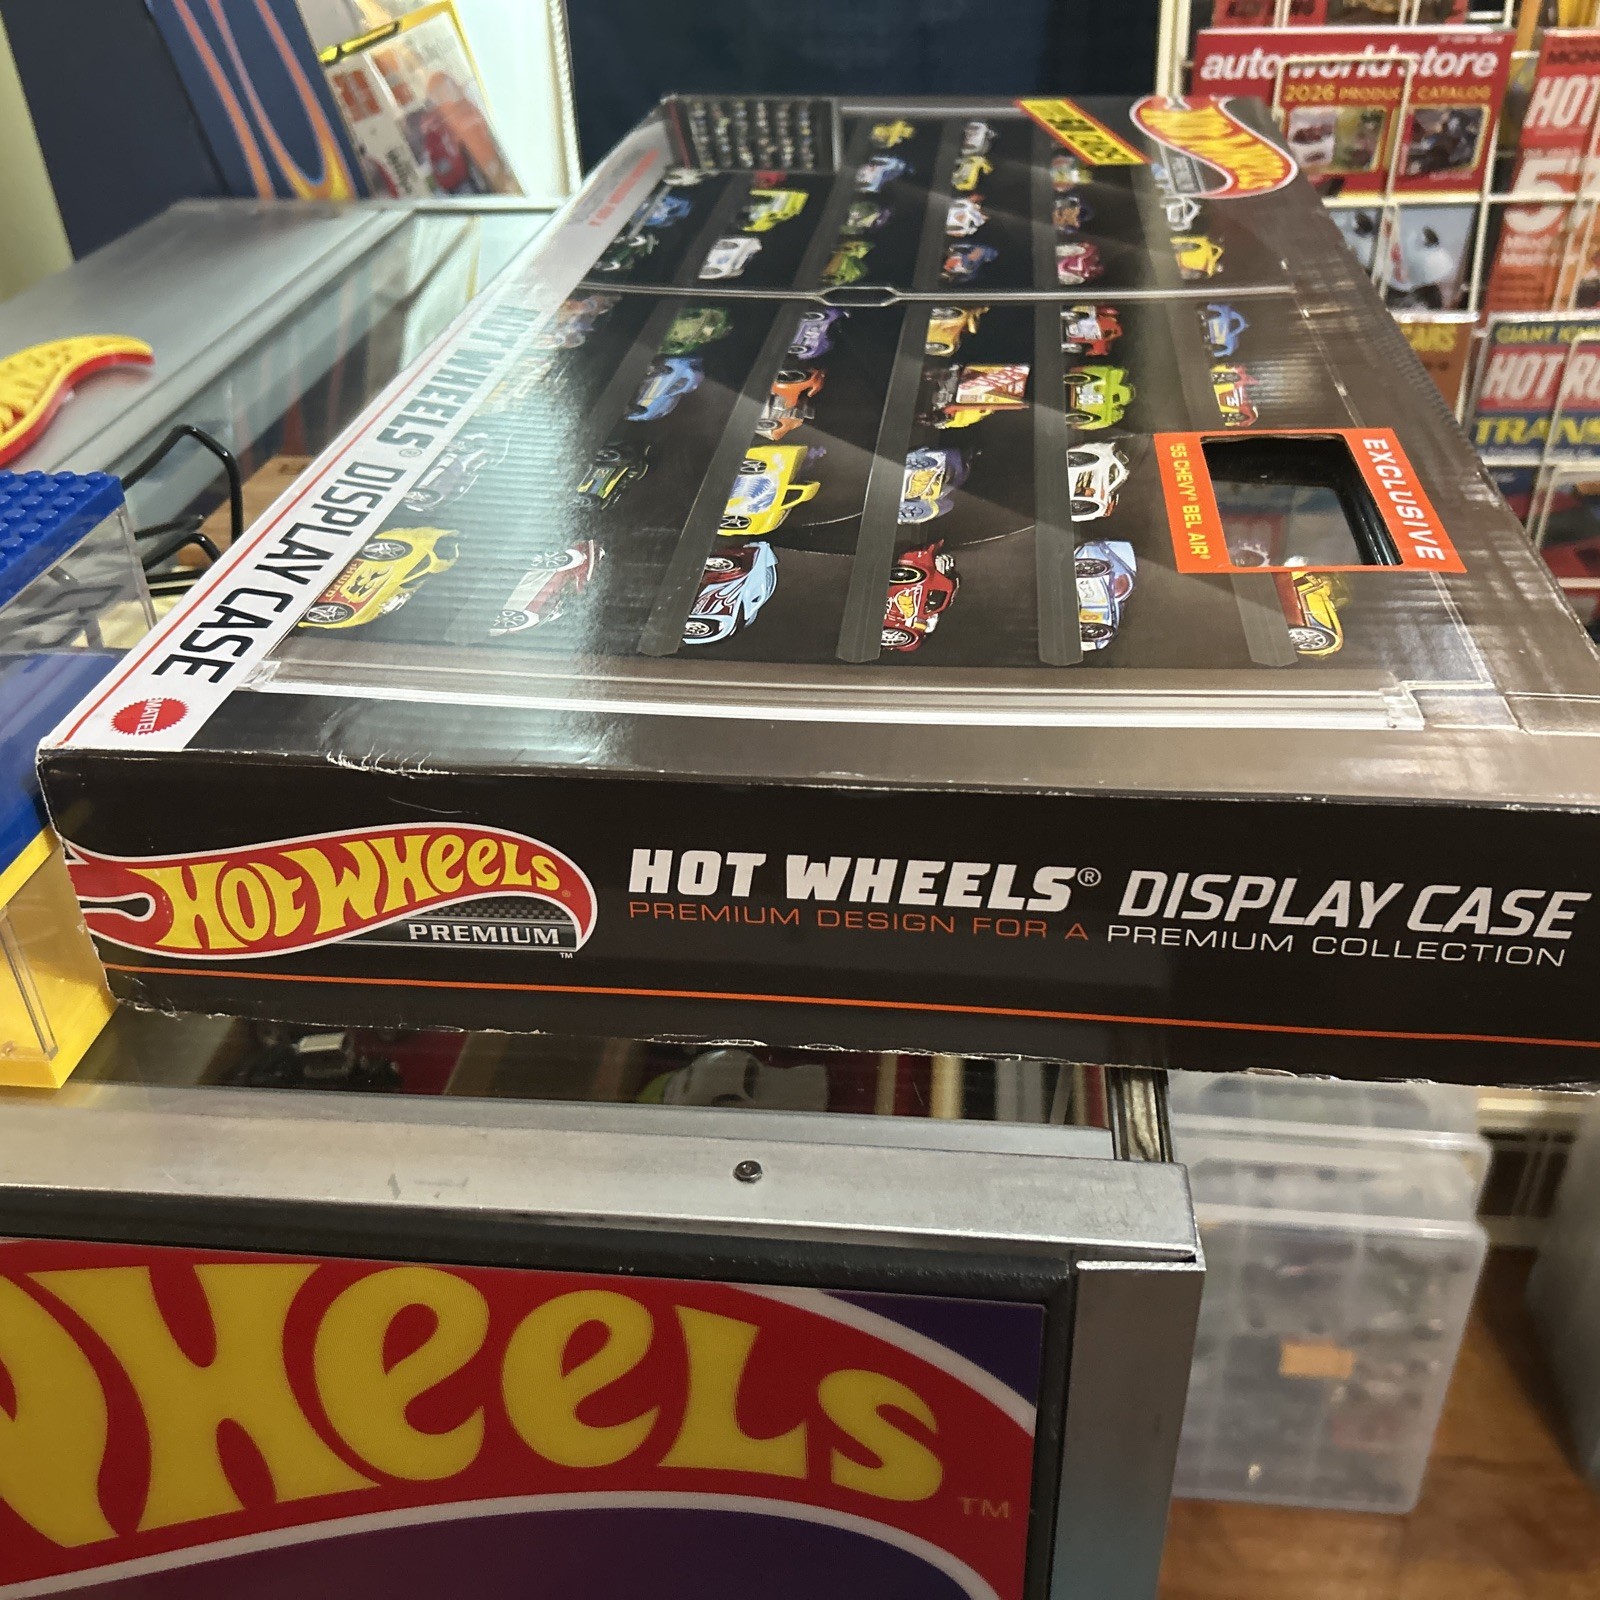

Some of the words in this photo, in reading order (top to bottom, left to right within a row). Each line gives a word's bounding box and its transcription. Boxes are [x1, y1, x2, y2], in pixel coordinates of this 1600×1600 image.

[1285, 84, 1336, 102] 2026
[1338, 86, 1410, 101] PRODUC
[1480, 352, 1565, 400] HOT
[254, 461, 406, 588] DISPLAY
[1182, 505, 1202, 528] BEL
[1362, 437, 1445, 561] EXCLUSIVE
[151, 586, 294, 684] CASE
[135, 698, 164, 735] MATTEL
[628, 848, 767, 897] HOT
[1118, 869, 1404, 929] DISPLAY
[1406, 885, 1592, 940] CASE
[407, 923, 561, 946] PREMIUM
[628, 901, 800, 926] PREMIUM
[817, 909, 955, 934] DESIGN
[972, 916, 1048, 939] FOR
[1064, 922, 1089, 941] A
[1106, 924, 1294, 954] PREMIUM
[1311, 936, 1566, 968] COLLECTION
